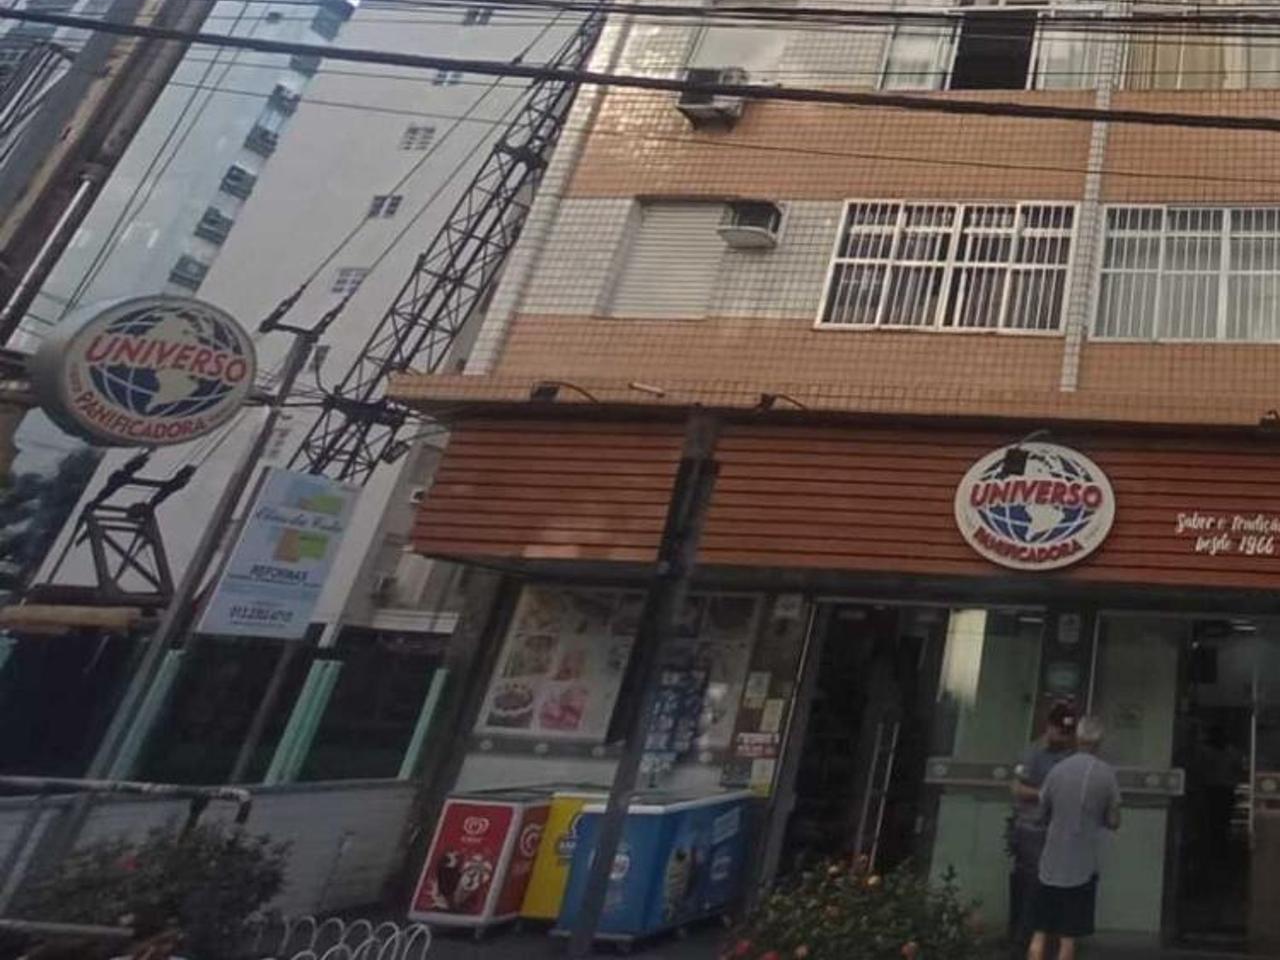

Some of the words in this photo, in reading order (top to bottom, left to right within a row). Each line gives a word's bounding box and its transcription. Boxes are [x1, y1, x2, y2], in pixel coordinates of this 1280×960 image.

[85, 336, 247, 384] UNIVERSO
[75, 391, 205, 439] PANIFICADORA
[970, 480, 1103, 508] UNIVERSO
[973, 526, 1084, 562] PANIFICADORA
[1239, 535, 1275, 556] 1966
